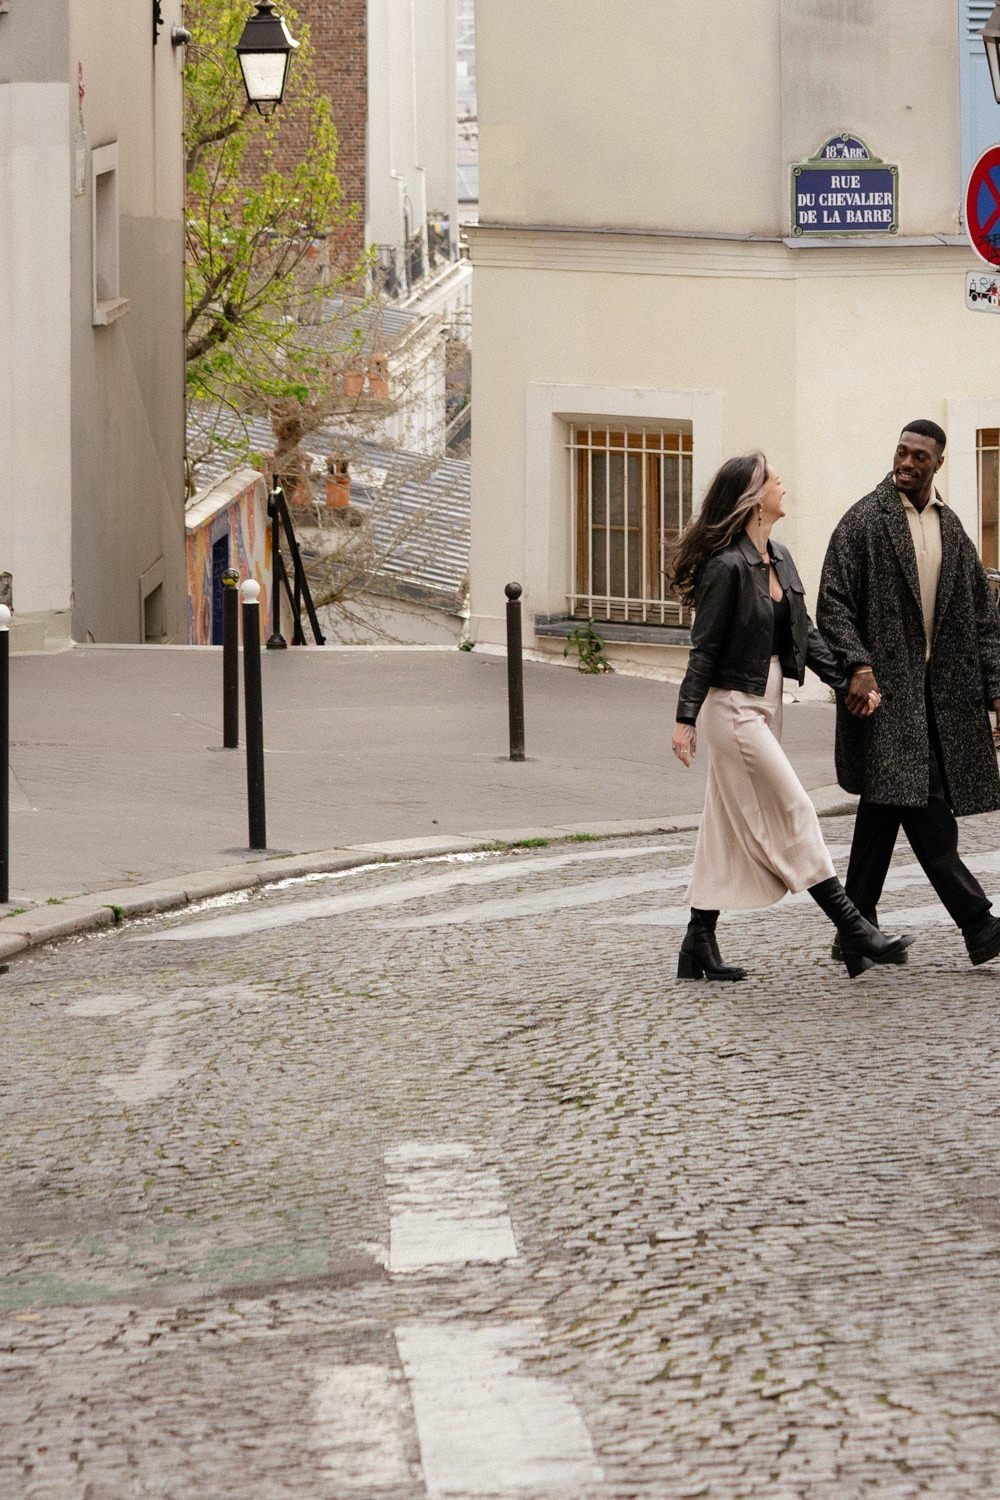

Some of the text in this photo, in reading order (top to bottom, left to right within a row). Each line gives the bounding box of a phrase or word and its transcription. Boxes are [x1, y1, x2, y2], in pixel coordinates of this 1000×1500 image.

[830, 175, 861, 189] RUE
[797, 192, 893, 207] DU CHEVALIER
[799, 209, 892, 224] DE LA BARRE
